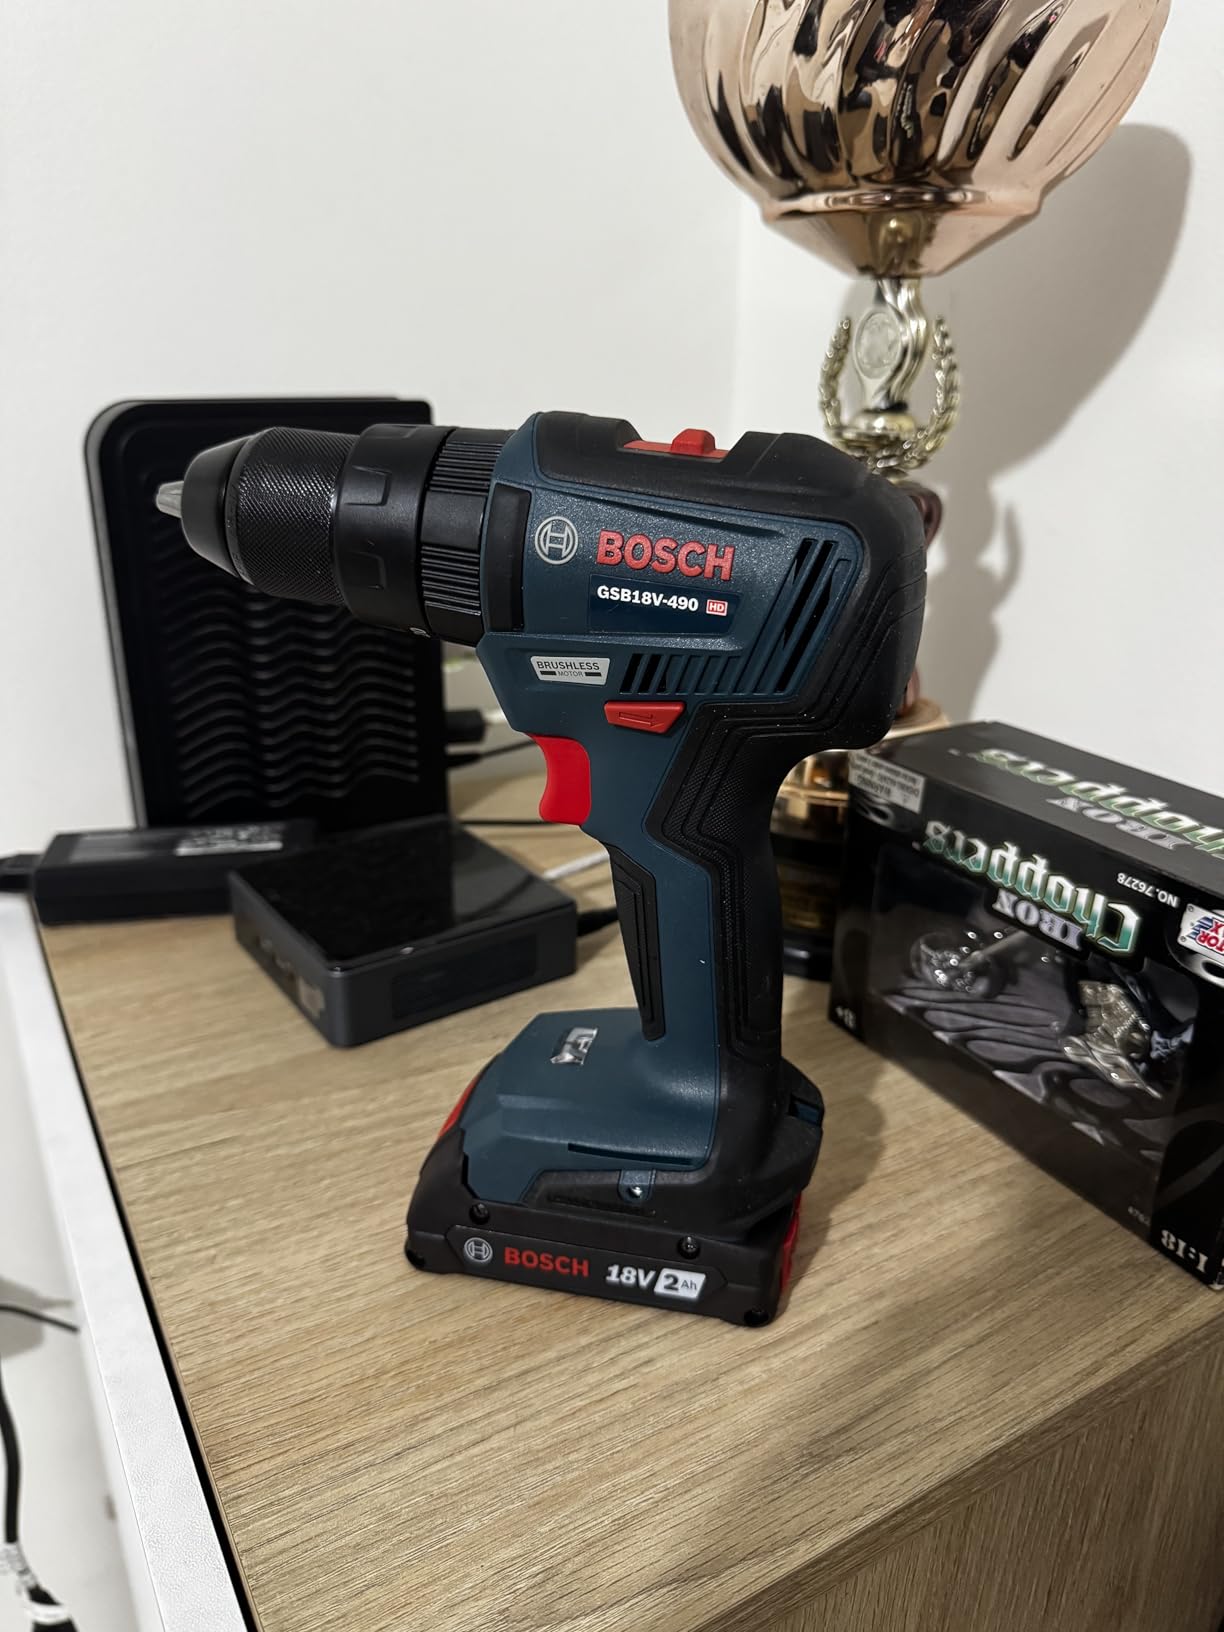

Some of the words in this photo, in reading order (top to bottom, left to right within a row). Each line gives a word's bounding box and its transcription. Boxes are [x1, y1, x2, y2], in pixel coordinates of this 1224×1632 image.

[596, 528, 735, 581] BOSCH
[597, 585, 698, 611] GSB18V-490
[709, 602, 725, 613] HD
[536, 660, 600, 671] BRUSHLESS
[557, 670, 584, 678] MOTOR
[975, 748, 1224, 860] hoppers
[923, 820, 1140, 952] Choppers
[1117, 872, 1178, 908] NO.76278
[992, 889, 1083, 950] IRON
[1197, 931, 1224, 953] TOR
[503, 1247, 590, 1277] BOSCH
[1161, 1229, 1208, 1273] 1:18
[605, 1264, 656, 1289] 18V
